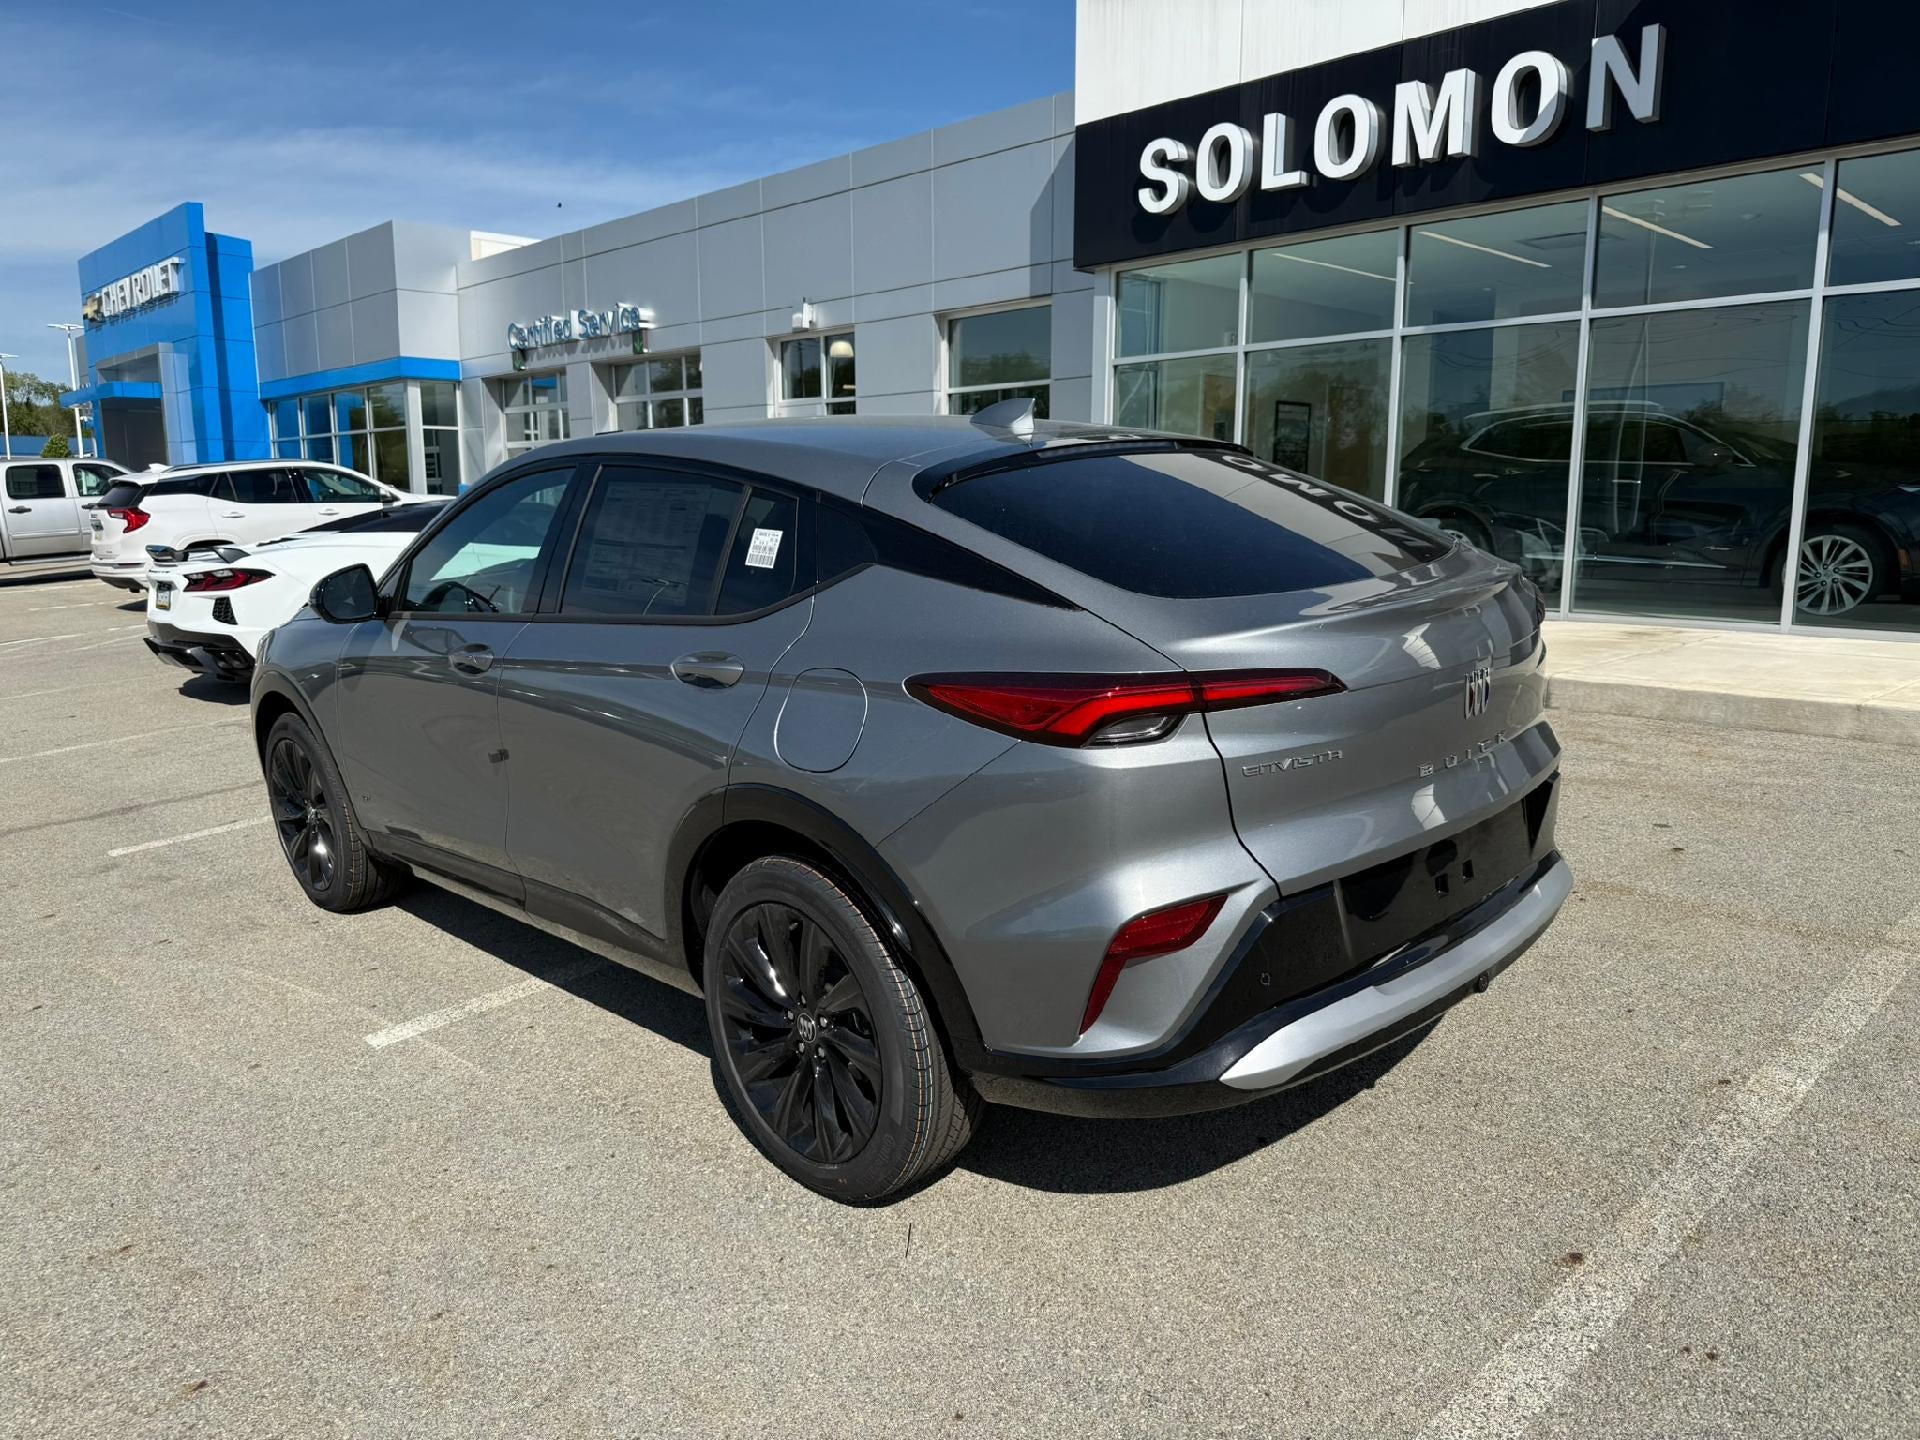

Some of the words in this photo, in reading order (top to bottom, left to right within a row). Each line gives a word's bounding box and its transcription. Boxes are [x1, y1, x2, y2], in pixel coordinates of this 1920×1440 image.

[1138, 23, 1665, 215] SOLOMON
[101, 257, 184, 317] CHEVROLET
[508, 311, 575, 350] Certified
[578, 302, 642, 340] Service
[1241, 749, 1344, 777] ENVISTA
[1419, 732, 1506, 778] BUICK
